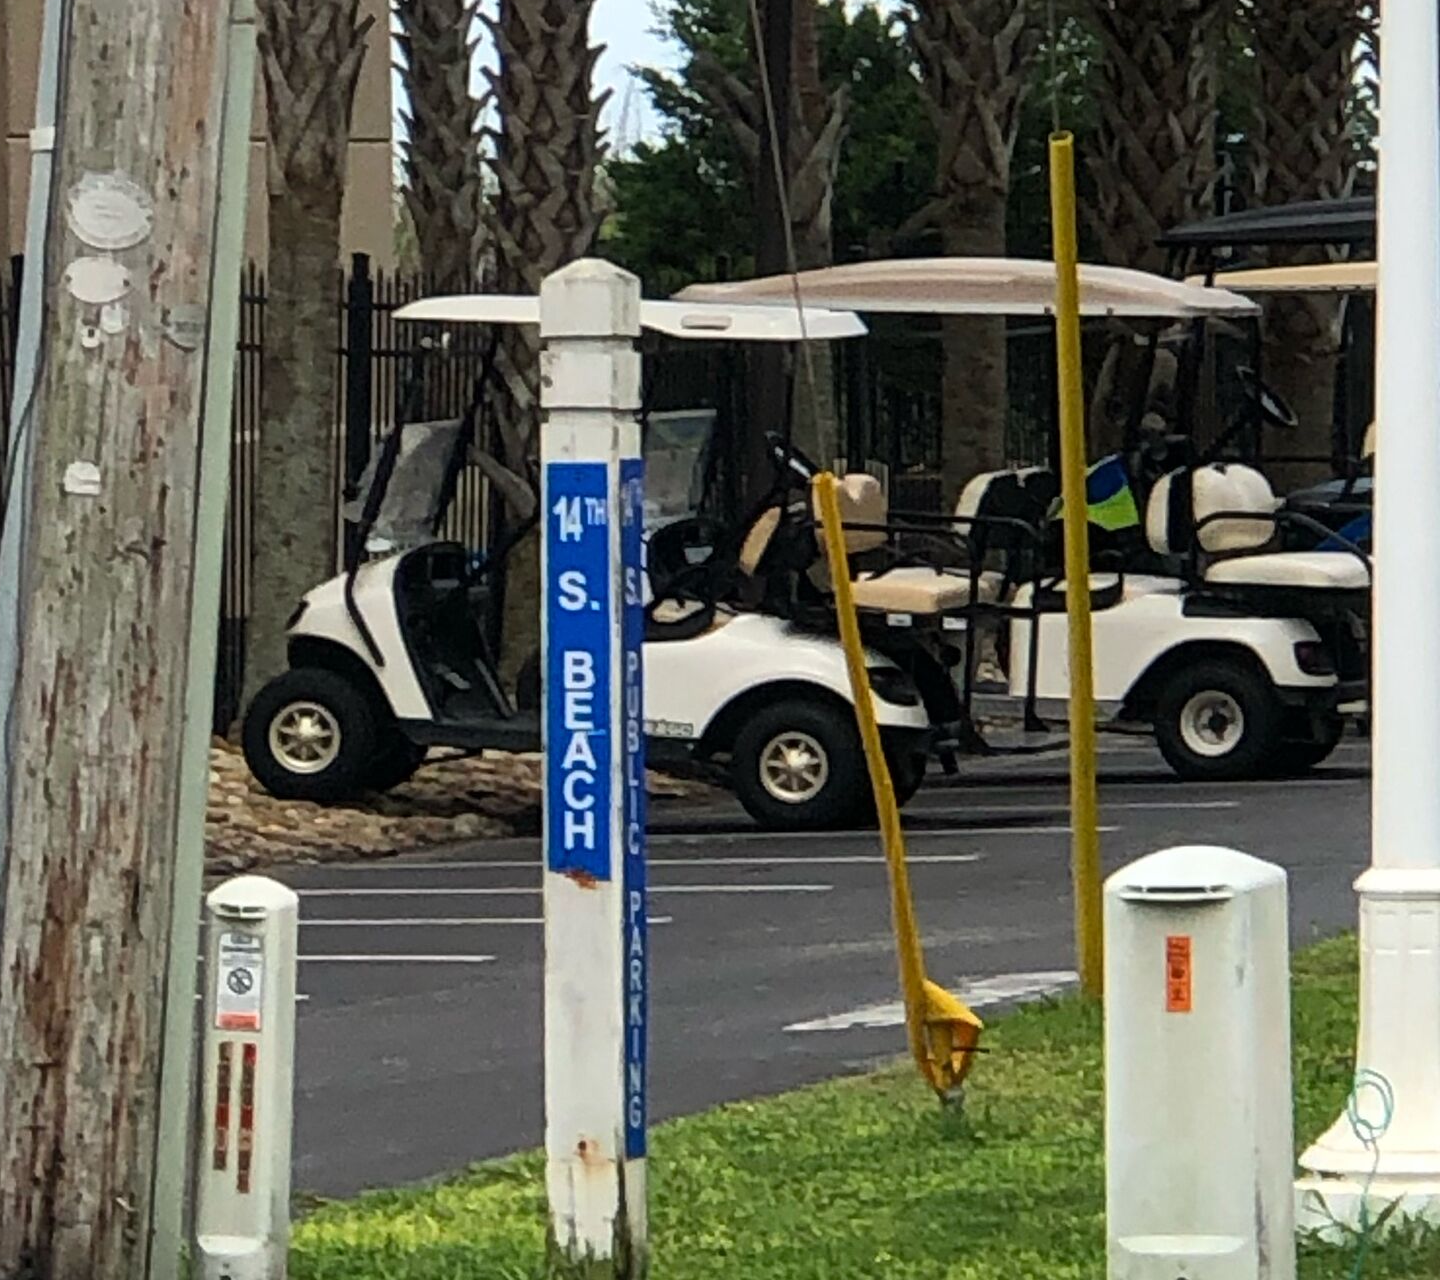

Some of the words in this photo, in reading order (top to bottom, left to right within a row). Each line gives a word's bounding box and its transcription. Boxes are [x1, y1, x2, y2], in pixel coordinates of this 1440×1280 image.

[552, 495, 608, 542] 14TH
[558, 570, 601, 611] S.
[561, 650, 598, 851] BEACH
[625, 650, 640, 855] PUBLIC
[629, 890, 643, 1129] PARKING
